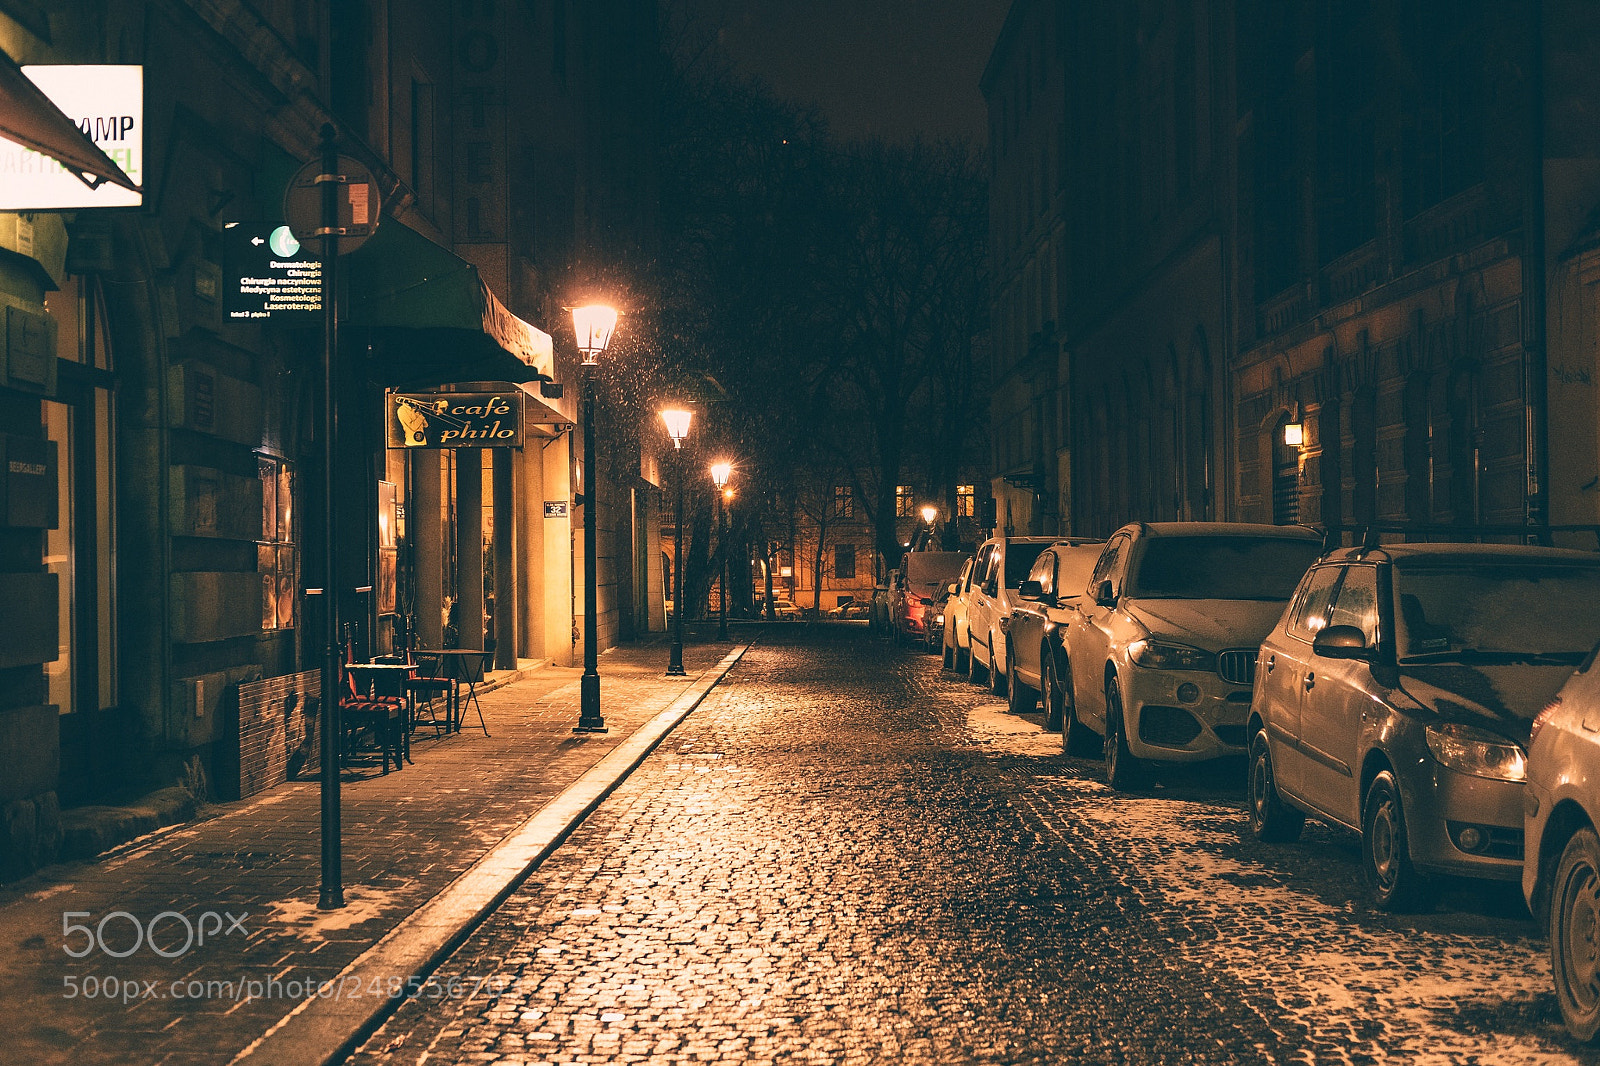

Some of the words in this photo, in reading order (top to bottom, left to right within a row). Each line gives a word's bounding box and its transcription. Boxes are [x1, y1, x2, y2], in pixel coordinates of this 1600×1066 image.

[69, 116, 134, 141] AMP
[269, 261, 322, 269] Dermatologia
[287, 270, 322, 278] Chirurgia
[240, 278, 276, 287] Chirurgia
[277, 278, 322, 286] naczyniowa
[240, 286, 281, 294] Medycyna
[281, 286, 322, 294] estetyczna
[269, 294, 322, 303] Kosmetologia
[264, 302, 322, 311] Laseroterapia
[452, 397, 510, 418] café
[441, 421, 515, 443] philo
